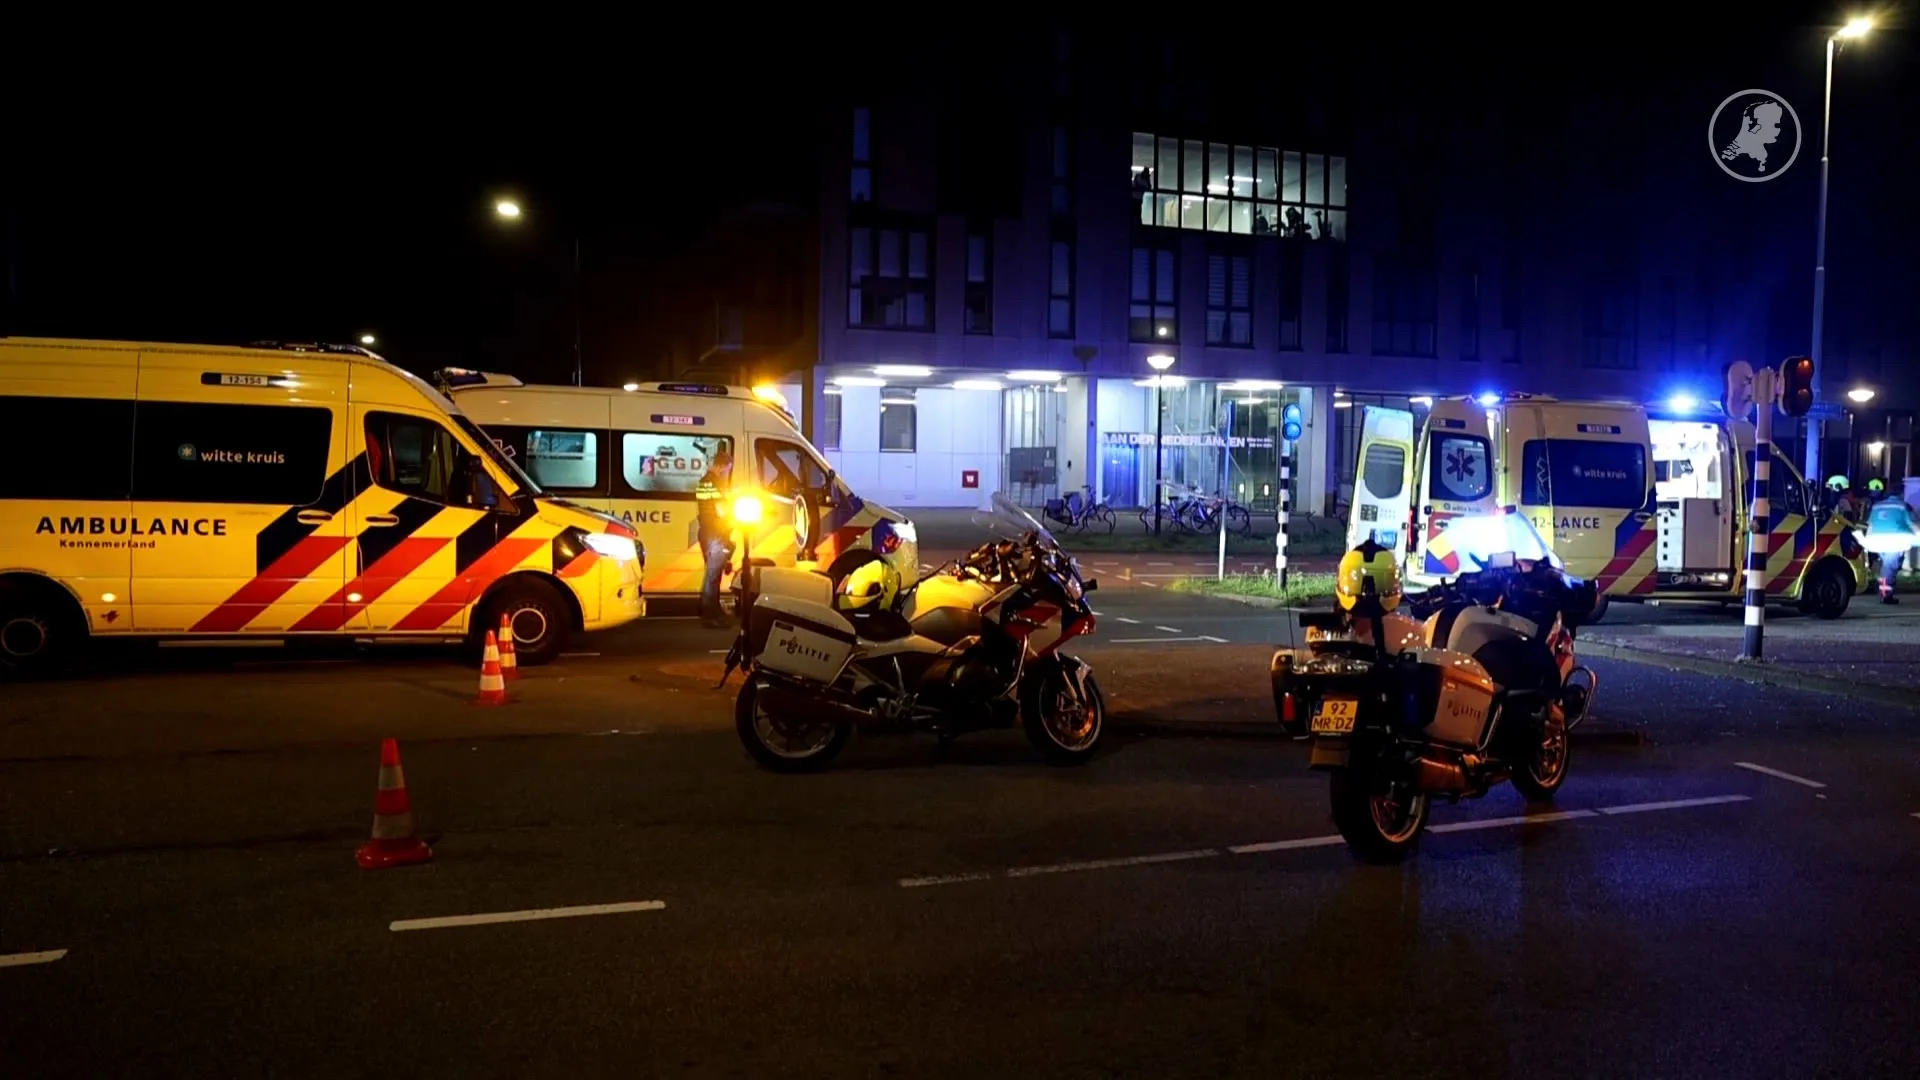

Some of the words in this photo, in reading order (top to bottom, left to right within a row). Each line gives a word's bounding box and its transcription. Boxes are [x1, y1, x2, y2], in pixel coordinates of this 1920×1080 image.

[201, 449, 243, 463] witte
[247, 451, 285, 464] kruis
[35, 516, 227, 536] AMBULANCE
[59, 539, 156, 549] Kennemerland
[780, 637, 831, 662] POLITIE
[1331, 702, 1348, 715] 92
